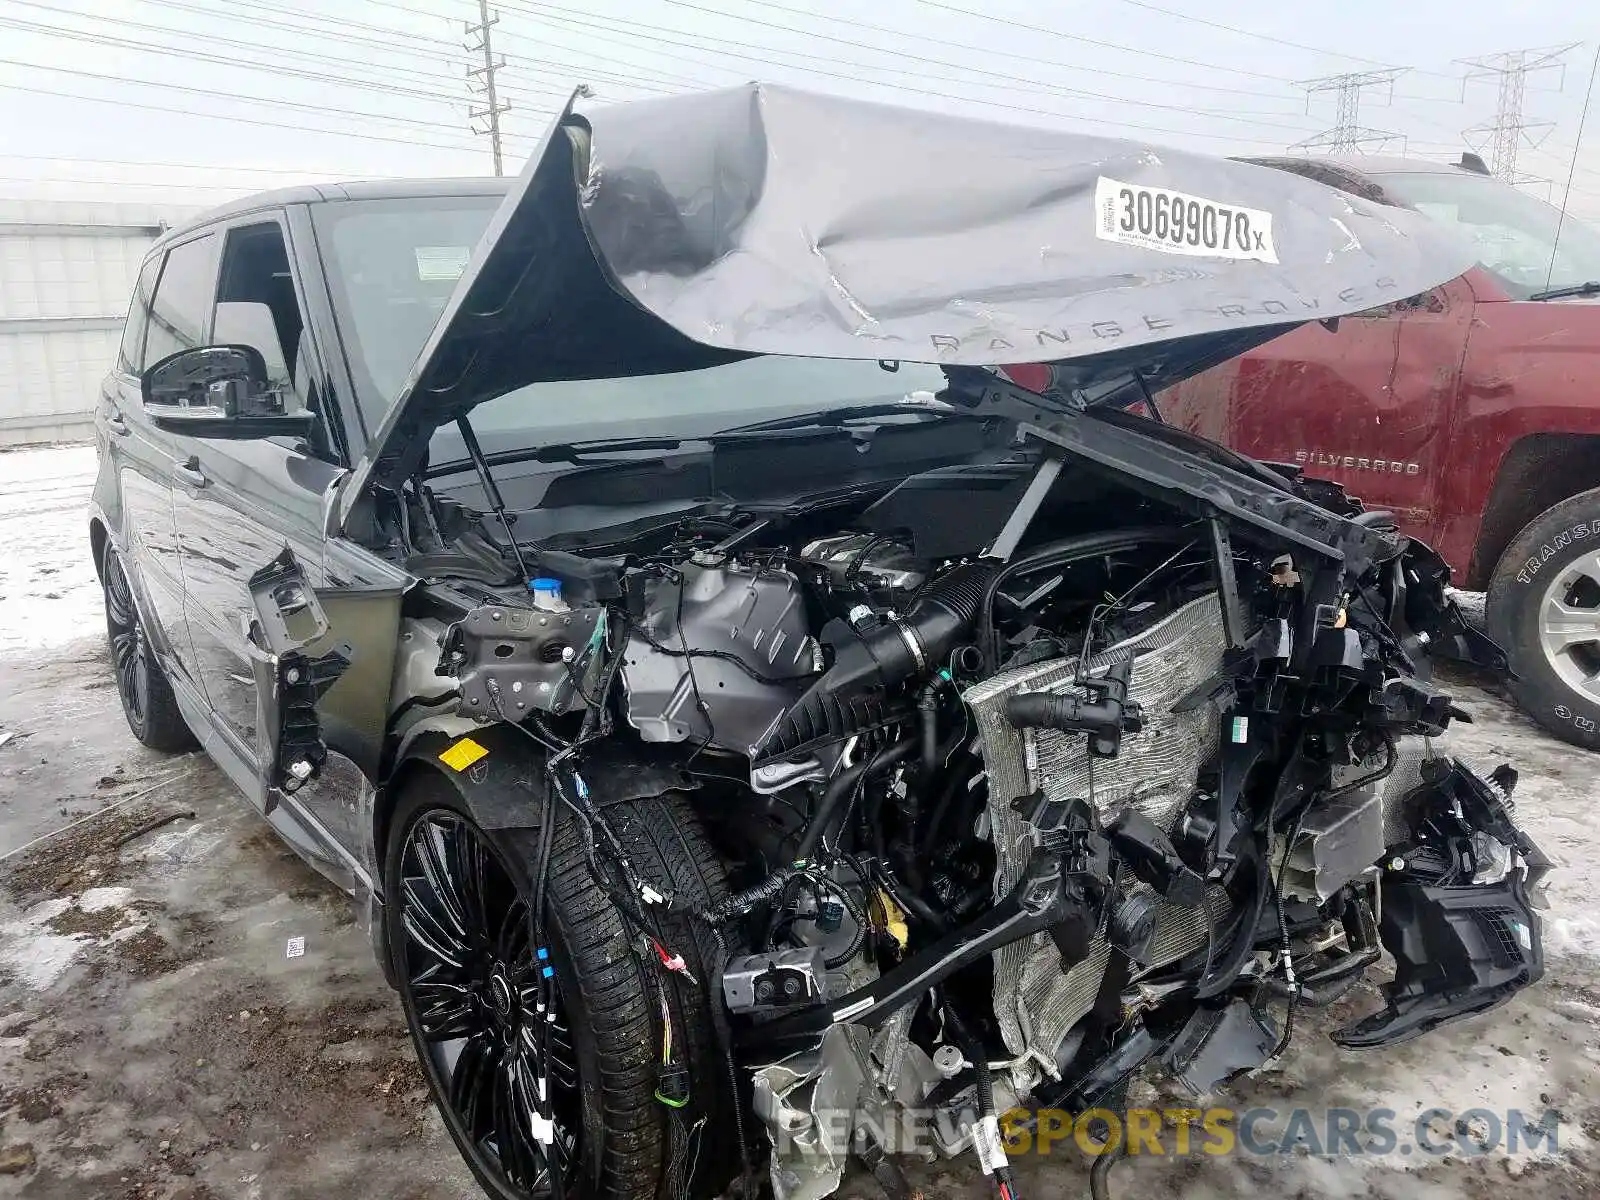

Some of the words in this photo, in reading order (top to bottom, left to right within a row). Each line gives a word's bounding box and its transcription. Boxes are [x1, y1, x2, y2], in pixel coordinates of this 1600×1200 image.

[929, 314, 1174, 353] RANGE
[1217, 276, 1397, 317] ROVER
[1296, 451, 1419, 474] SILVERADO
